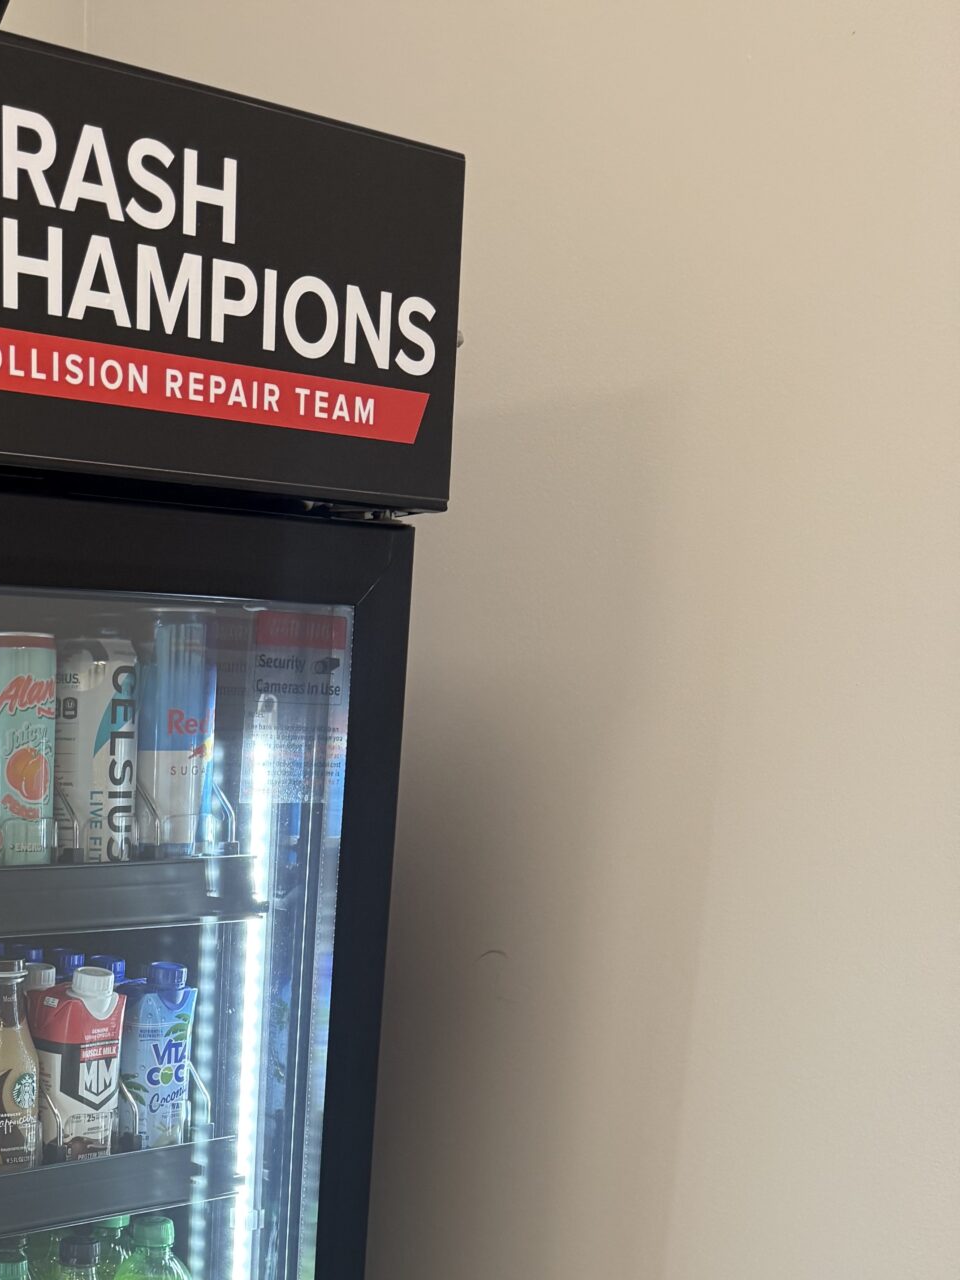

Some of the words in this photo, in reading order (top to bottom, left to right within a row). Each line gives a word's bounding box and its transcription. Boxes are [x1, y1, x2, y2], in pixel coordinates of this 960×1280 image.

[166, 370, 280, 413] REPAIR
[295, 388, 375, 427] TEAM
[257, 654, 306, 673] Security
[106, 665, 138, 862] CELSIUS
[170, 765, 208, 776] SUGA
[90, 791, 104, 829] LIVE
[146, 1063, 186, 1086] COC
